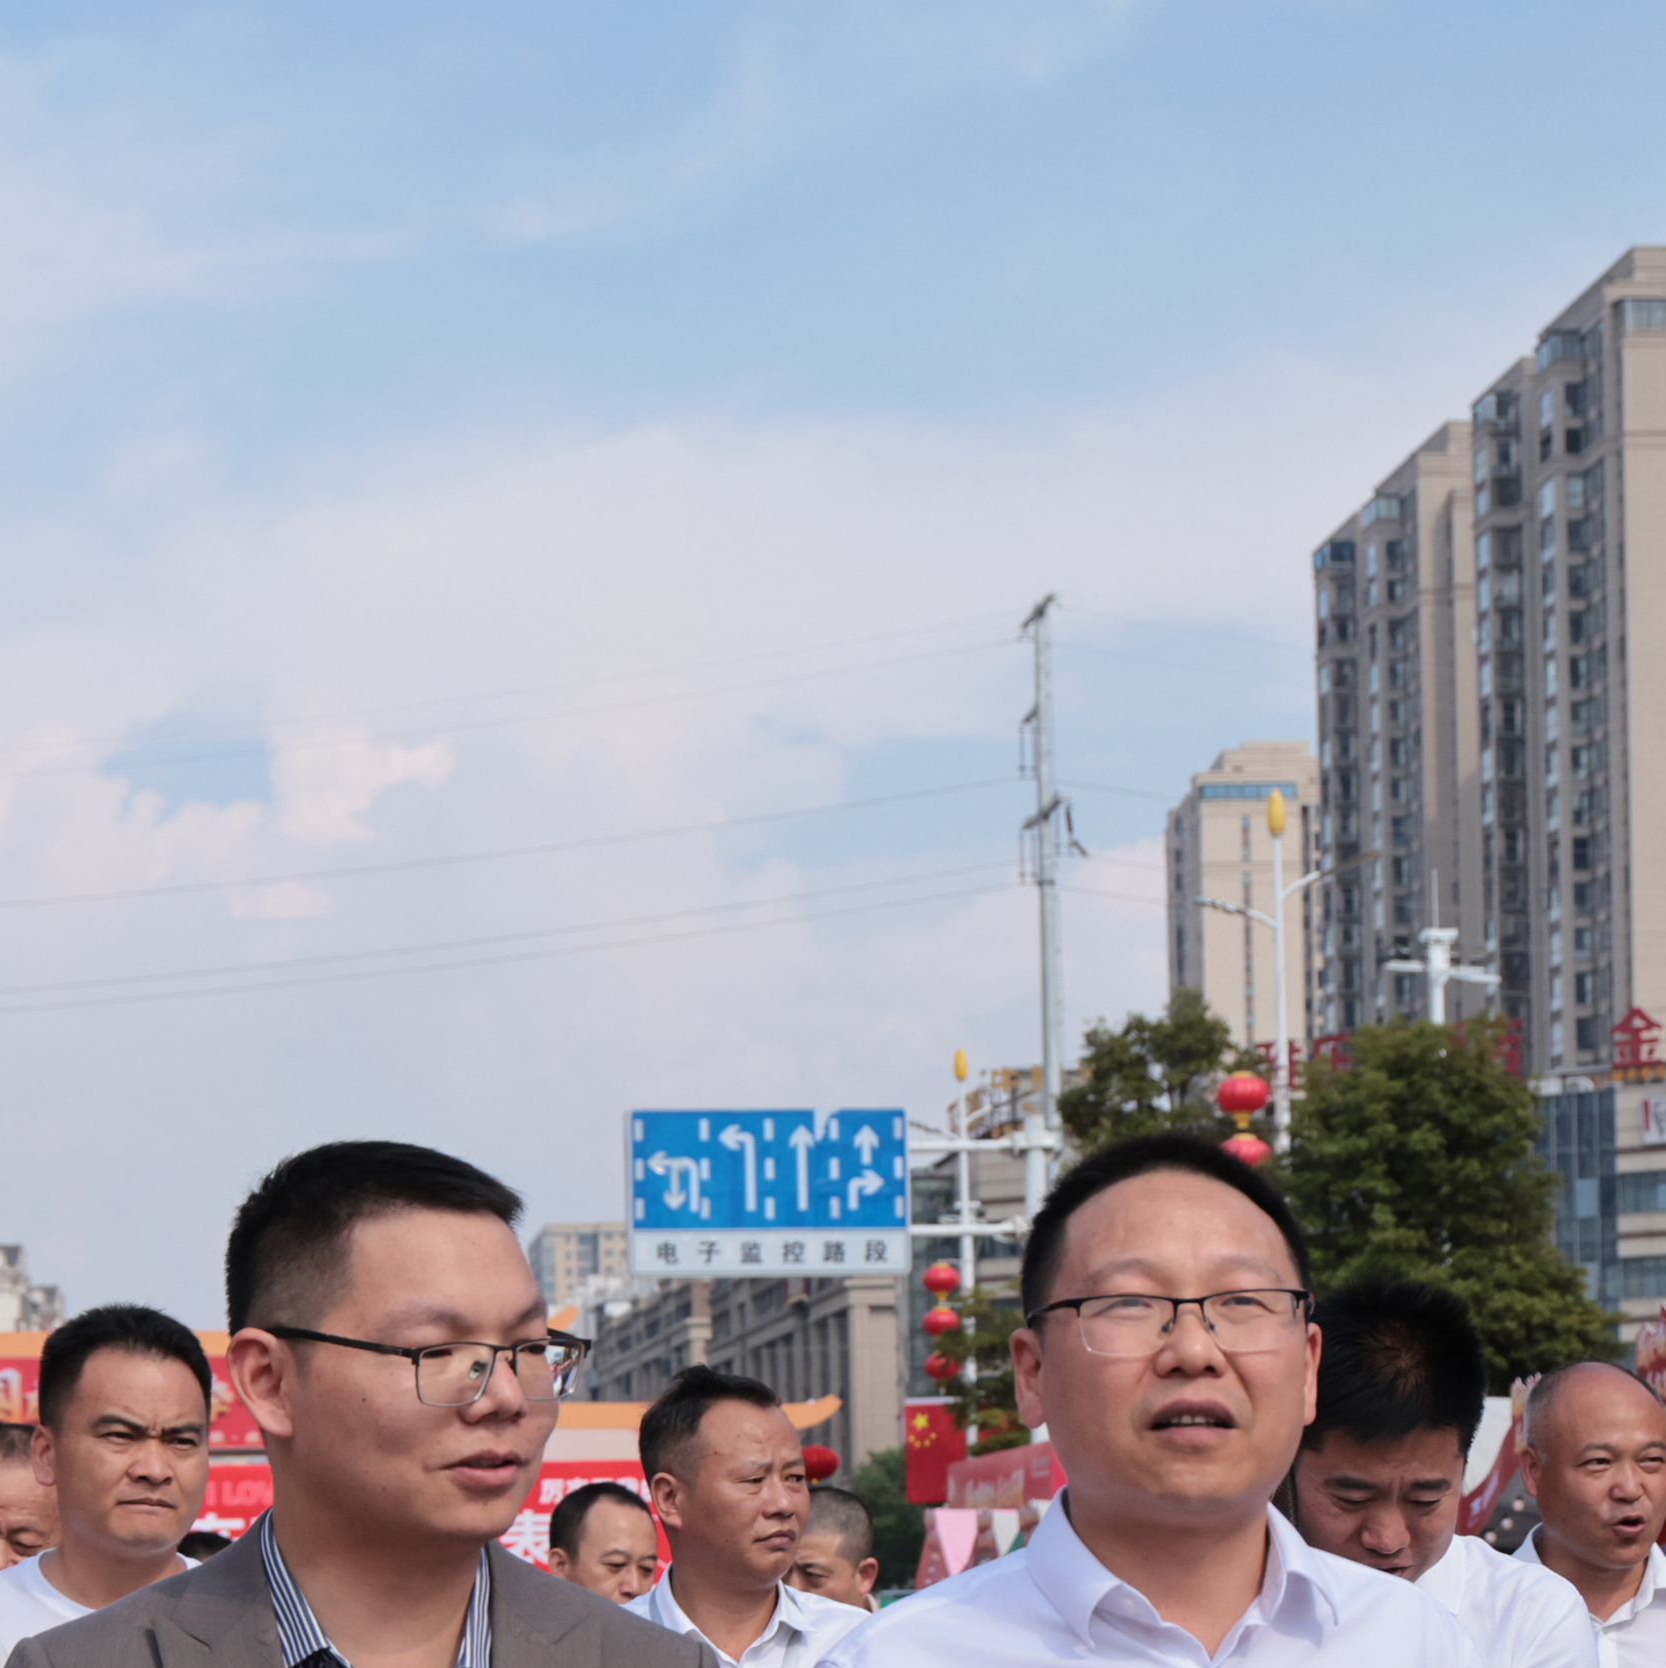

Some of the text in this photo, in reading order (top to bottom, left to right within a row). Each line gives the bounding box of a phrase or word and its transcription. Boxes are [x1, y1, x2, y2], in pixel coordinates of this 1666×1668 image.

[656, 1239, 889, 1265] 电子监控路段
